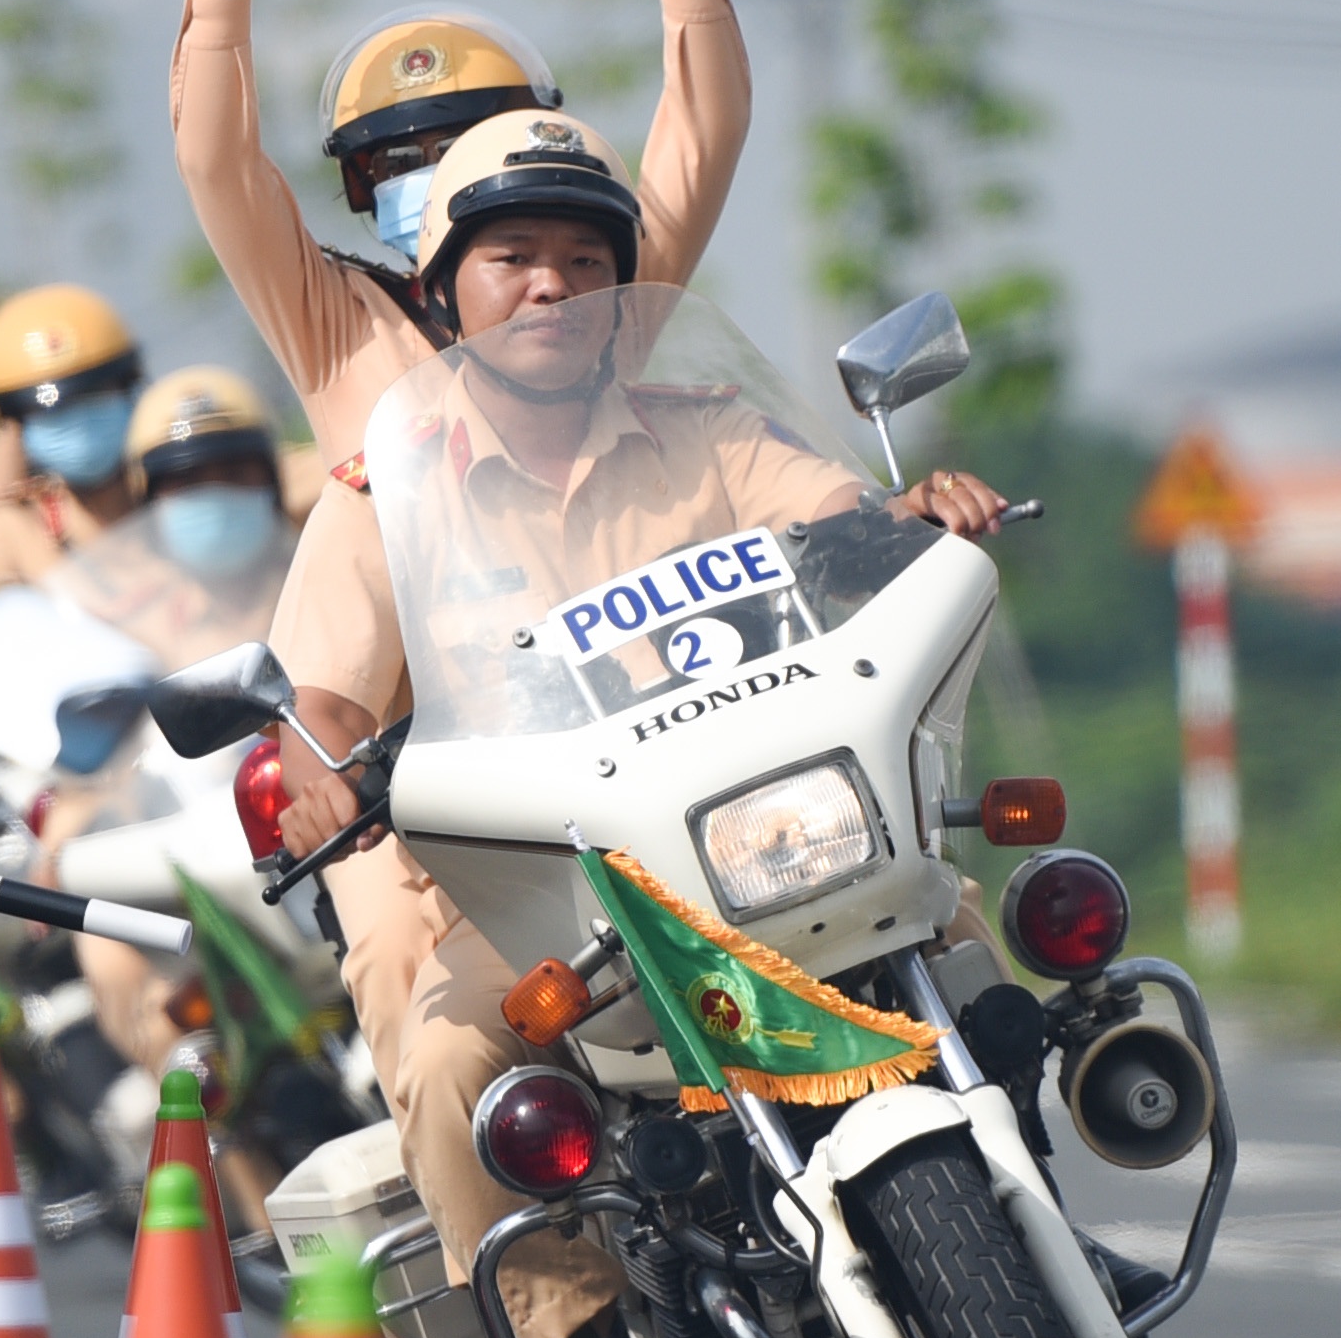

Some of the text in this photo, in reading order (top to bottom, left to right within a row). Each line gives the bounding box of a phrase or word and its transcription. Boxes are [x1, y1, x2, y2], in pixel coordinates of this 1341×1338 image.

[561, 536, 782, 654] POLICE
[671, 630, 713, 674] 2
[628, 662, 822, 745] HONDA
[288, 1232, 332, 1258] HONDA
